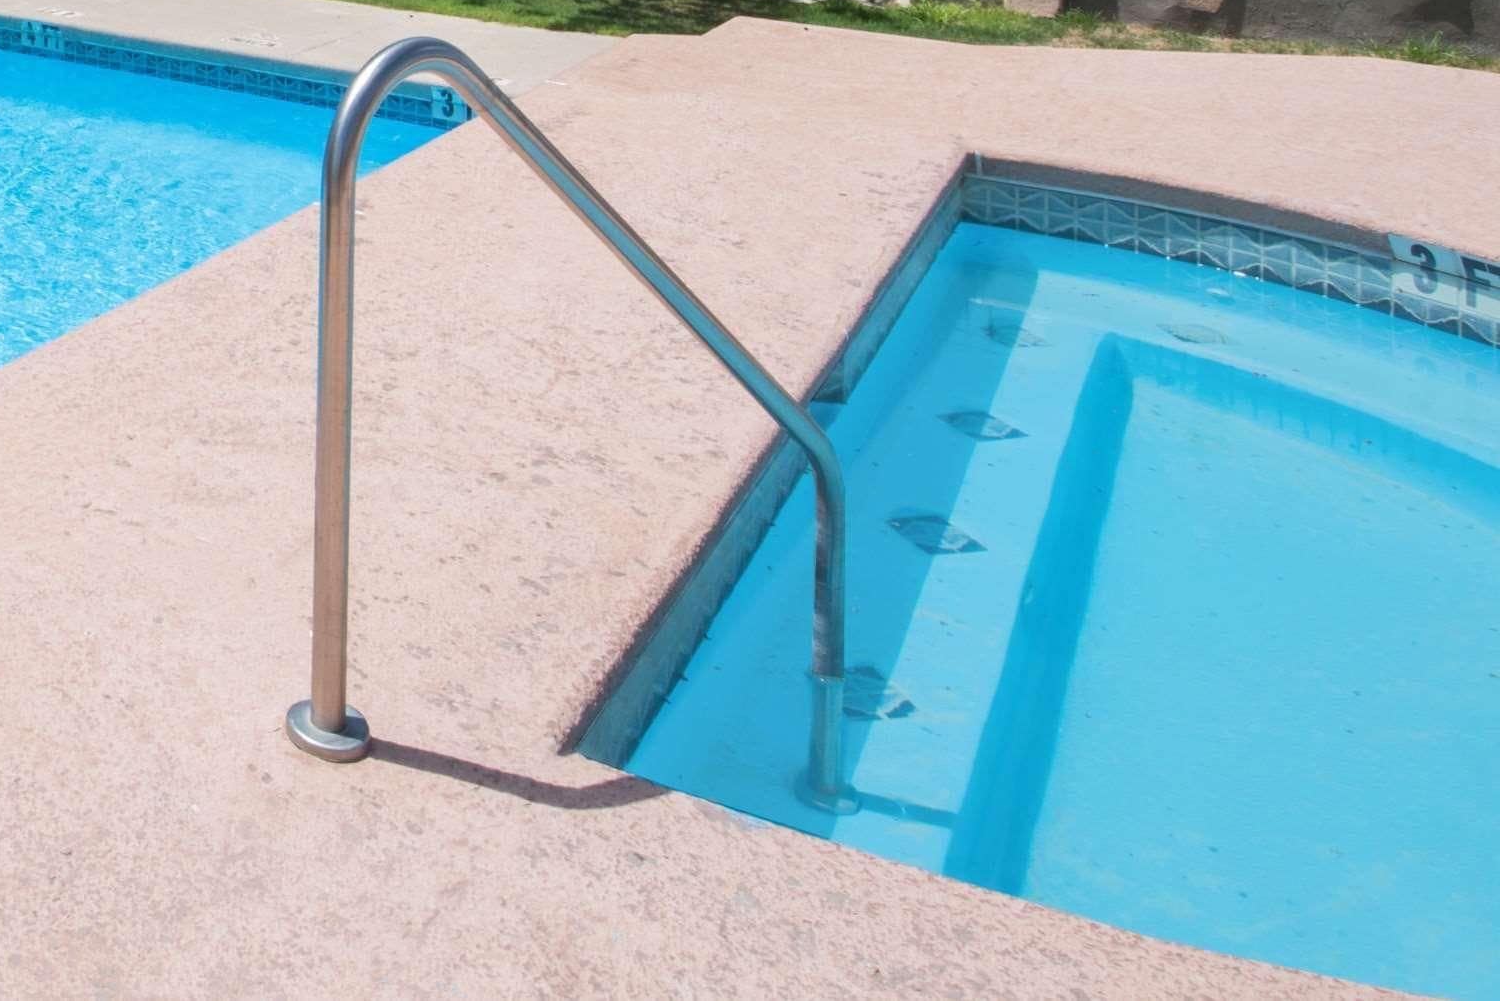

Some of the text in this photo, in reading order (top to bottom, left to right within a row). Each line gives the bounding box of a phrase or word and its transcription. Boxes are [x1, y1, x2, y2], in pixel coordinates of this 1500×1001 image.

[439, 89, 454, 117] 3
[1411, 243, 1500, 309] 3 F
